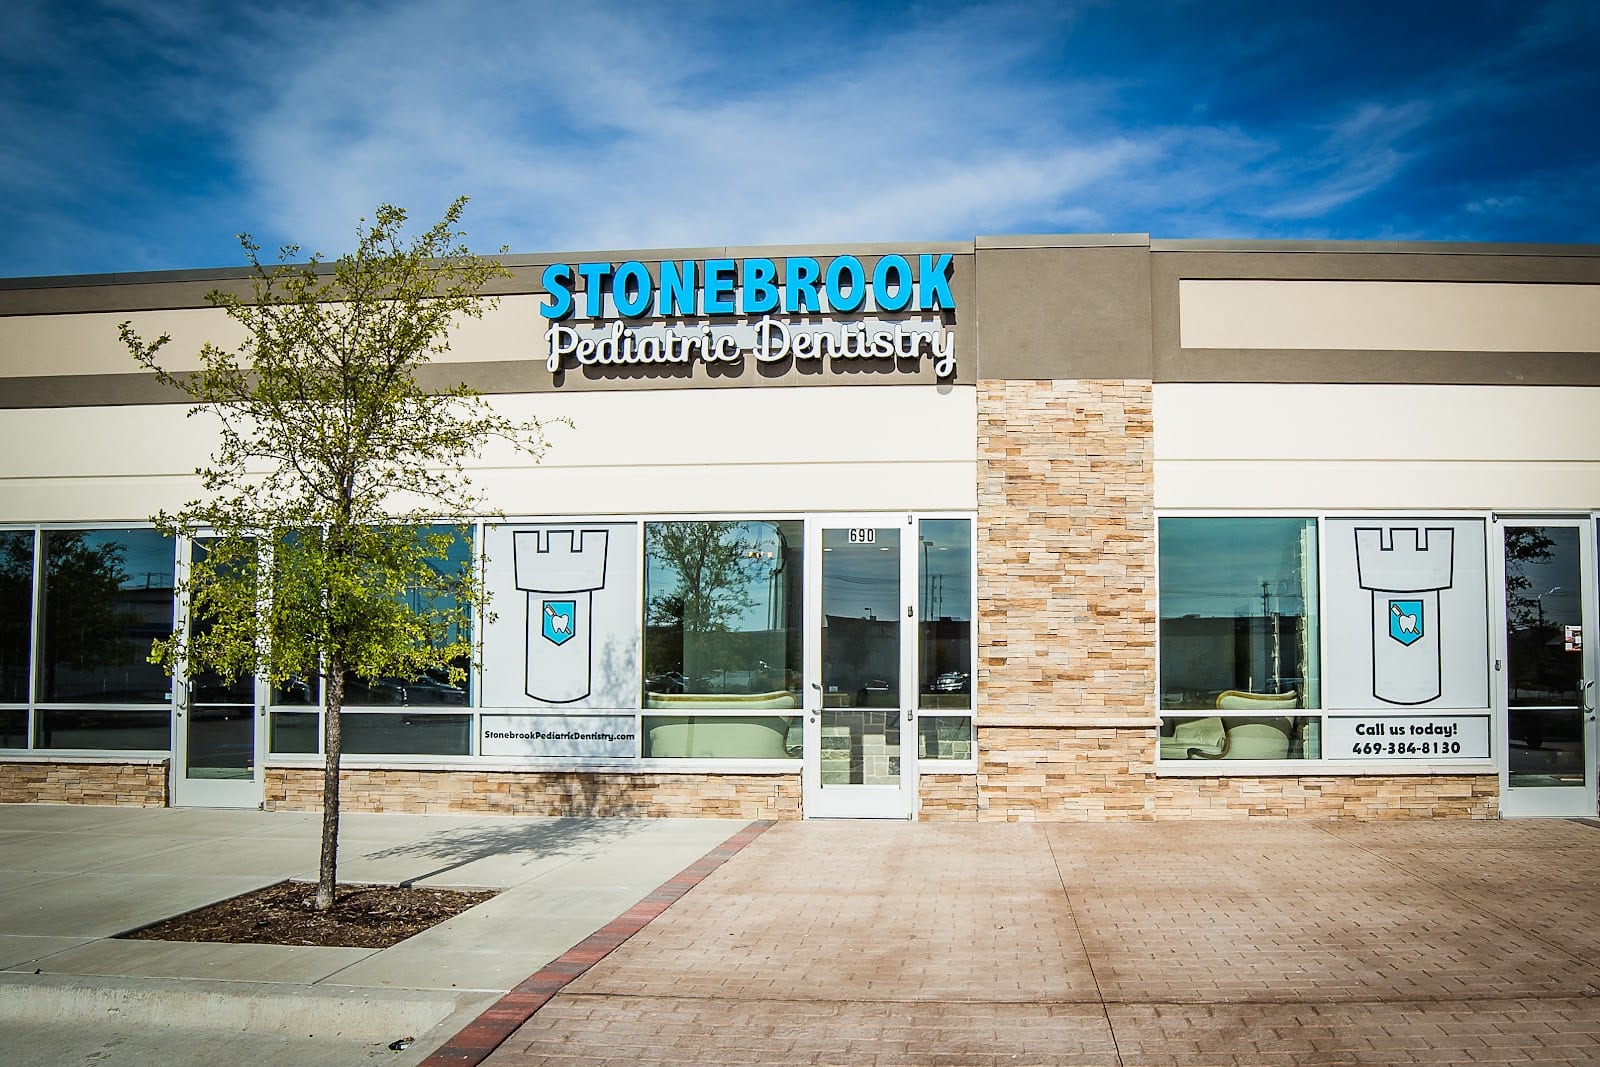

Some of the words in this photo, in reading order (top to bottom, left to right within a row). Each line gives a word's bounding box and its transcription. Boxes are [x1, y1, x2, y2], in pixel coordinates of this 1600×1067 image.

[540, 254, 956, 319] STONEBROOK
[545, 320, 741, 373] Pediatric
[753, 315, 956, 377] Dentistry
[850, 528, 874, 542] 690
[484, 730, 634, 742] StonebrookPediatricDentistry.com
[1355, 723, 1385, 736] Call
[1389, 725, 1406, 736] us
[1409, 723, 1458, 737] today!
[1352, 741, 1460, 754] 469-384-8130
